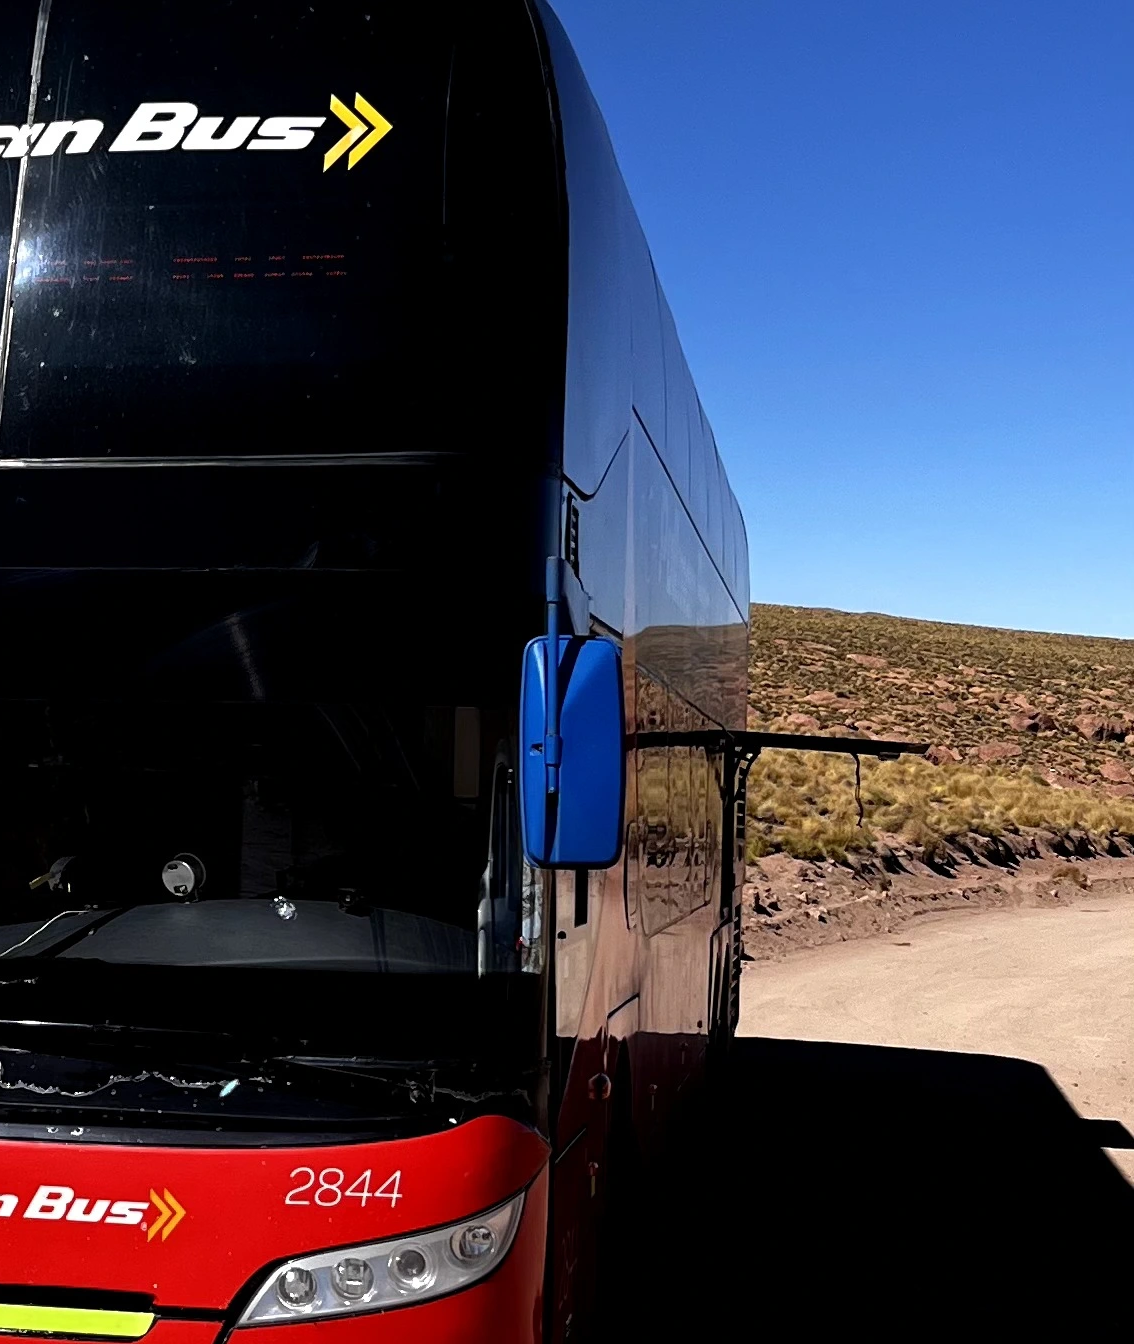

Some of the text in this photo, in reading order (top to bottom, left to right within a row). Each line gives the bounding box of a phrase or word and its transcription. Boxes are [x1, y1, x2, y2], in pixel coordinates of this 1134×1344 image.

[108, 101, 328, 153] Bus
[23, 1184, 150, 1225] Bus
[284, 1166, 403, 1209] 2844
